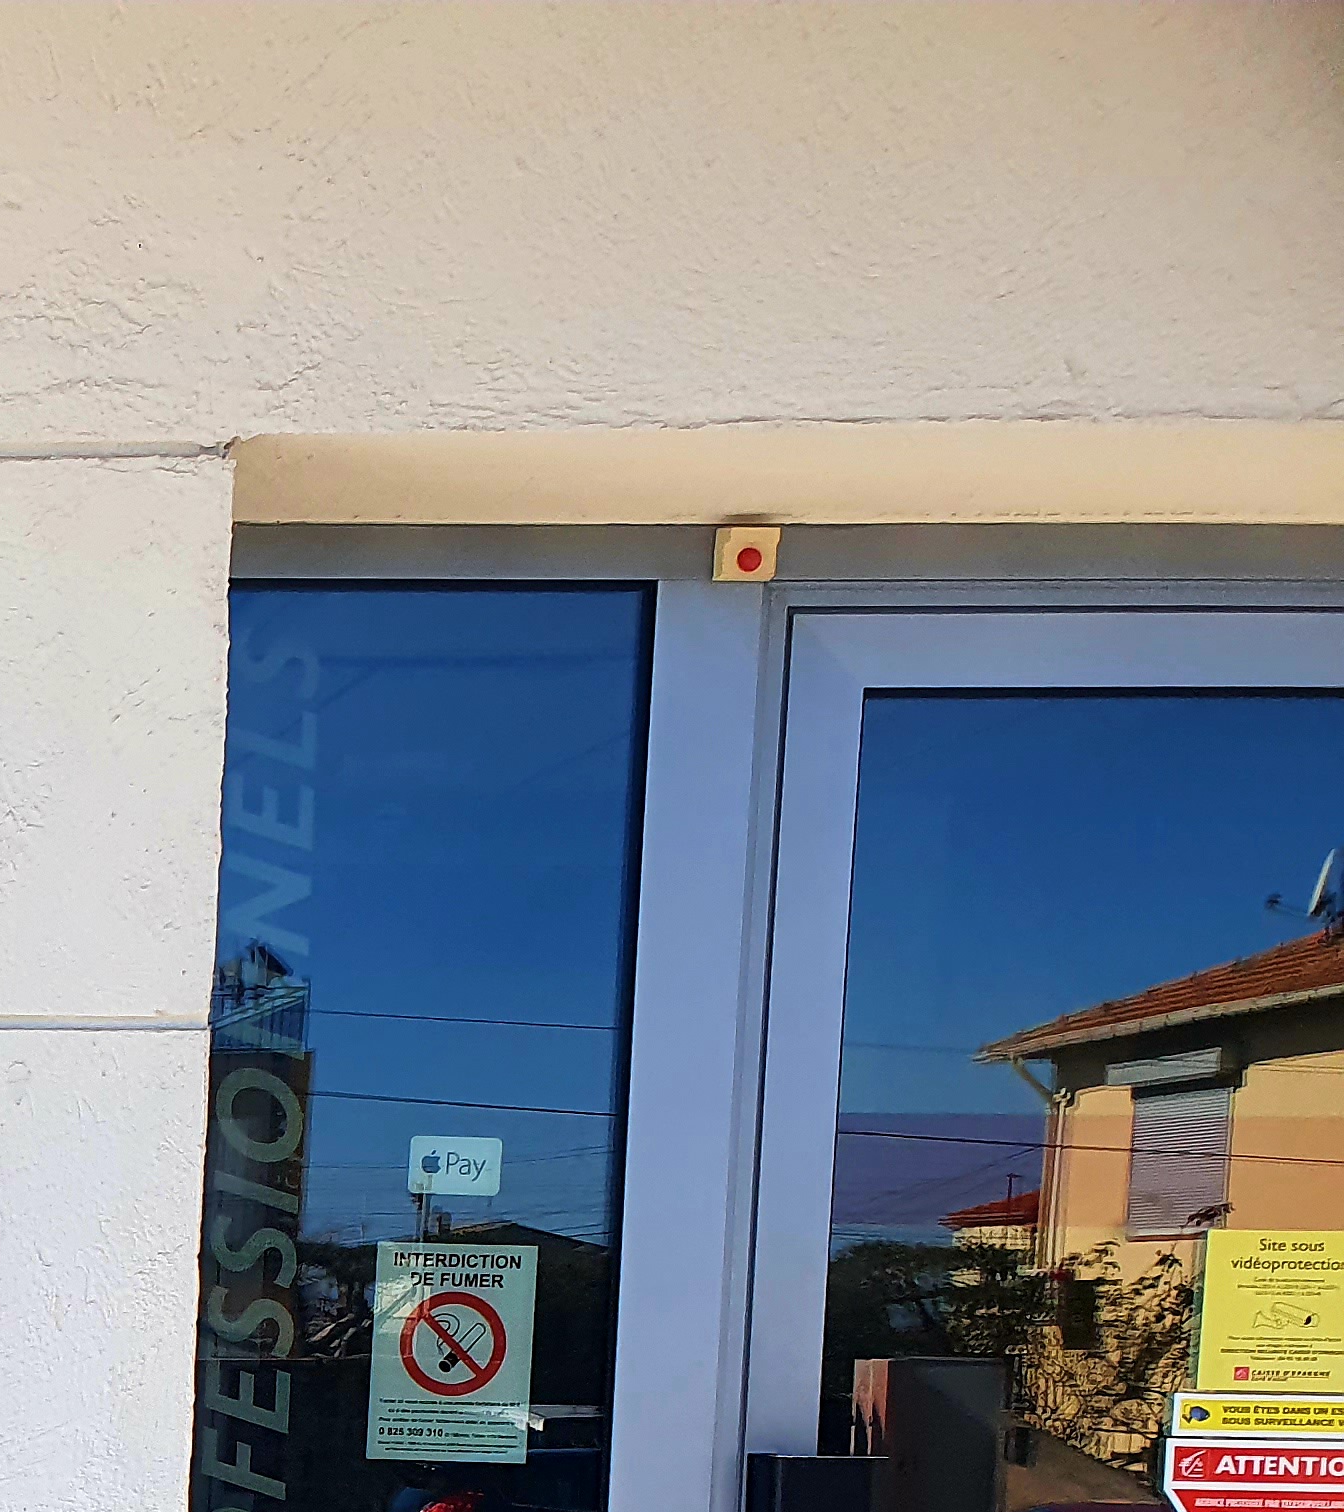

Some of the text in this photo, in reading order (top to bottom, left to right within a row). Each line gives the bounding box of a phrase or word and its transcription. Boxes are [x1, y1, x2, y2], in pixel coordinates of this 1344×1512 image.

[445, 1151, 487, 1182] Pay
[1259, 1238, 1325, 1252] Site sous
[393, 1252, 522, 1269] INTERDICTION
[410, 1272, 505, 1288] DE FUMER
[1282, 1406, 1311, 1415] DANS
[1313, 1407, 1329, 1415] UN
[1222, 1417, 1251, 1425] SOUS
[1254, 1417, 1334, 1426] SURVEILLANCE
[378, 1427, 385, 1435] 0
[387, 1427, 405, 1436] 825
[1213, 1454, 1344, 1477] ATTENTIO
